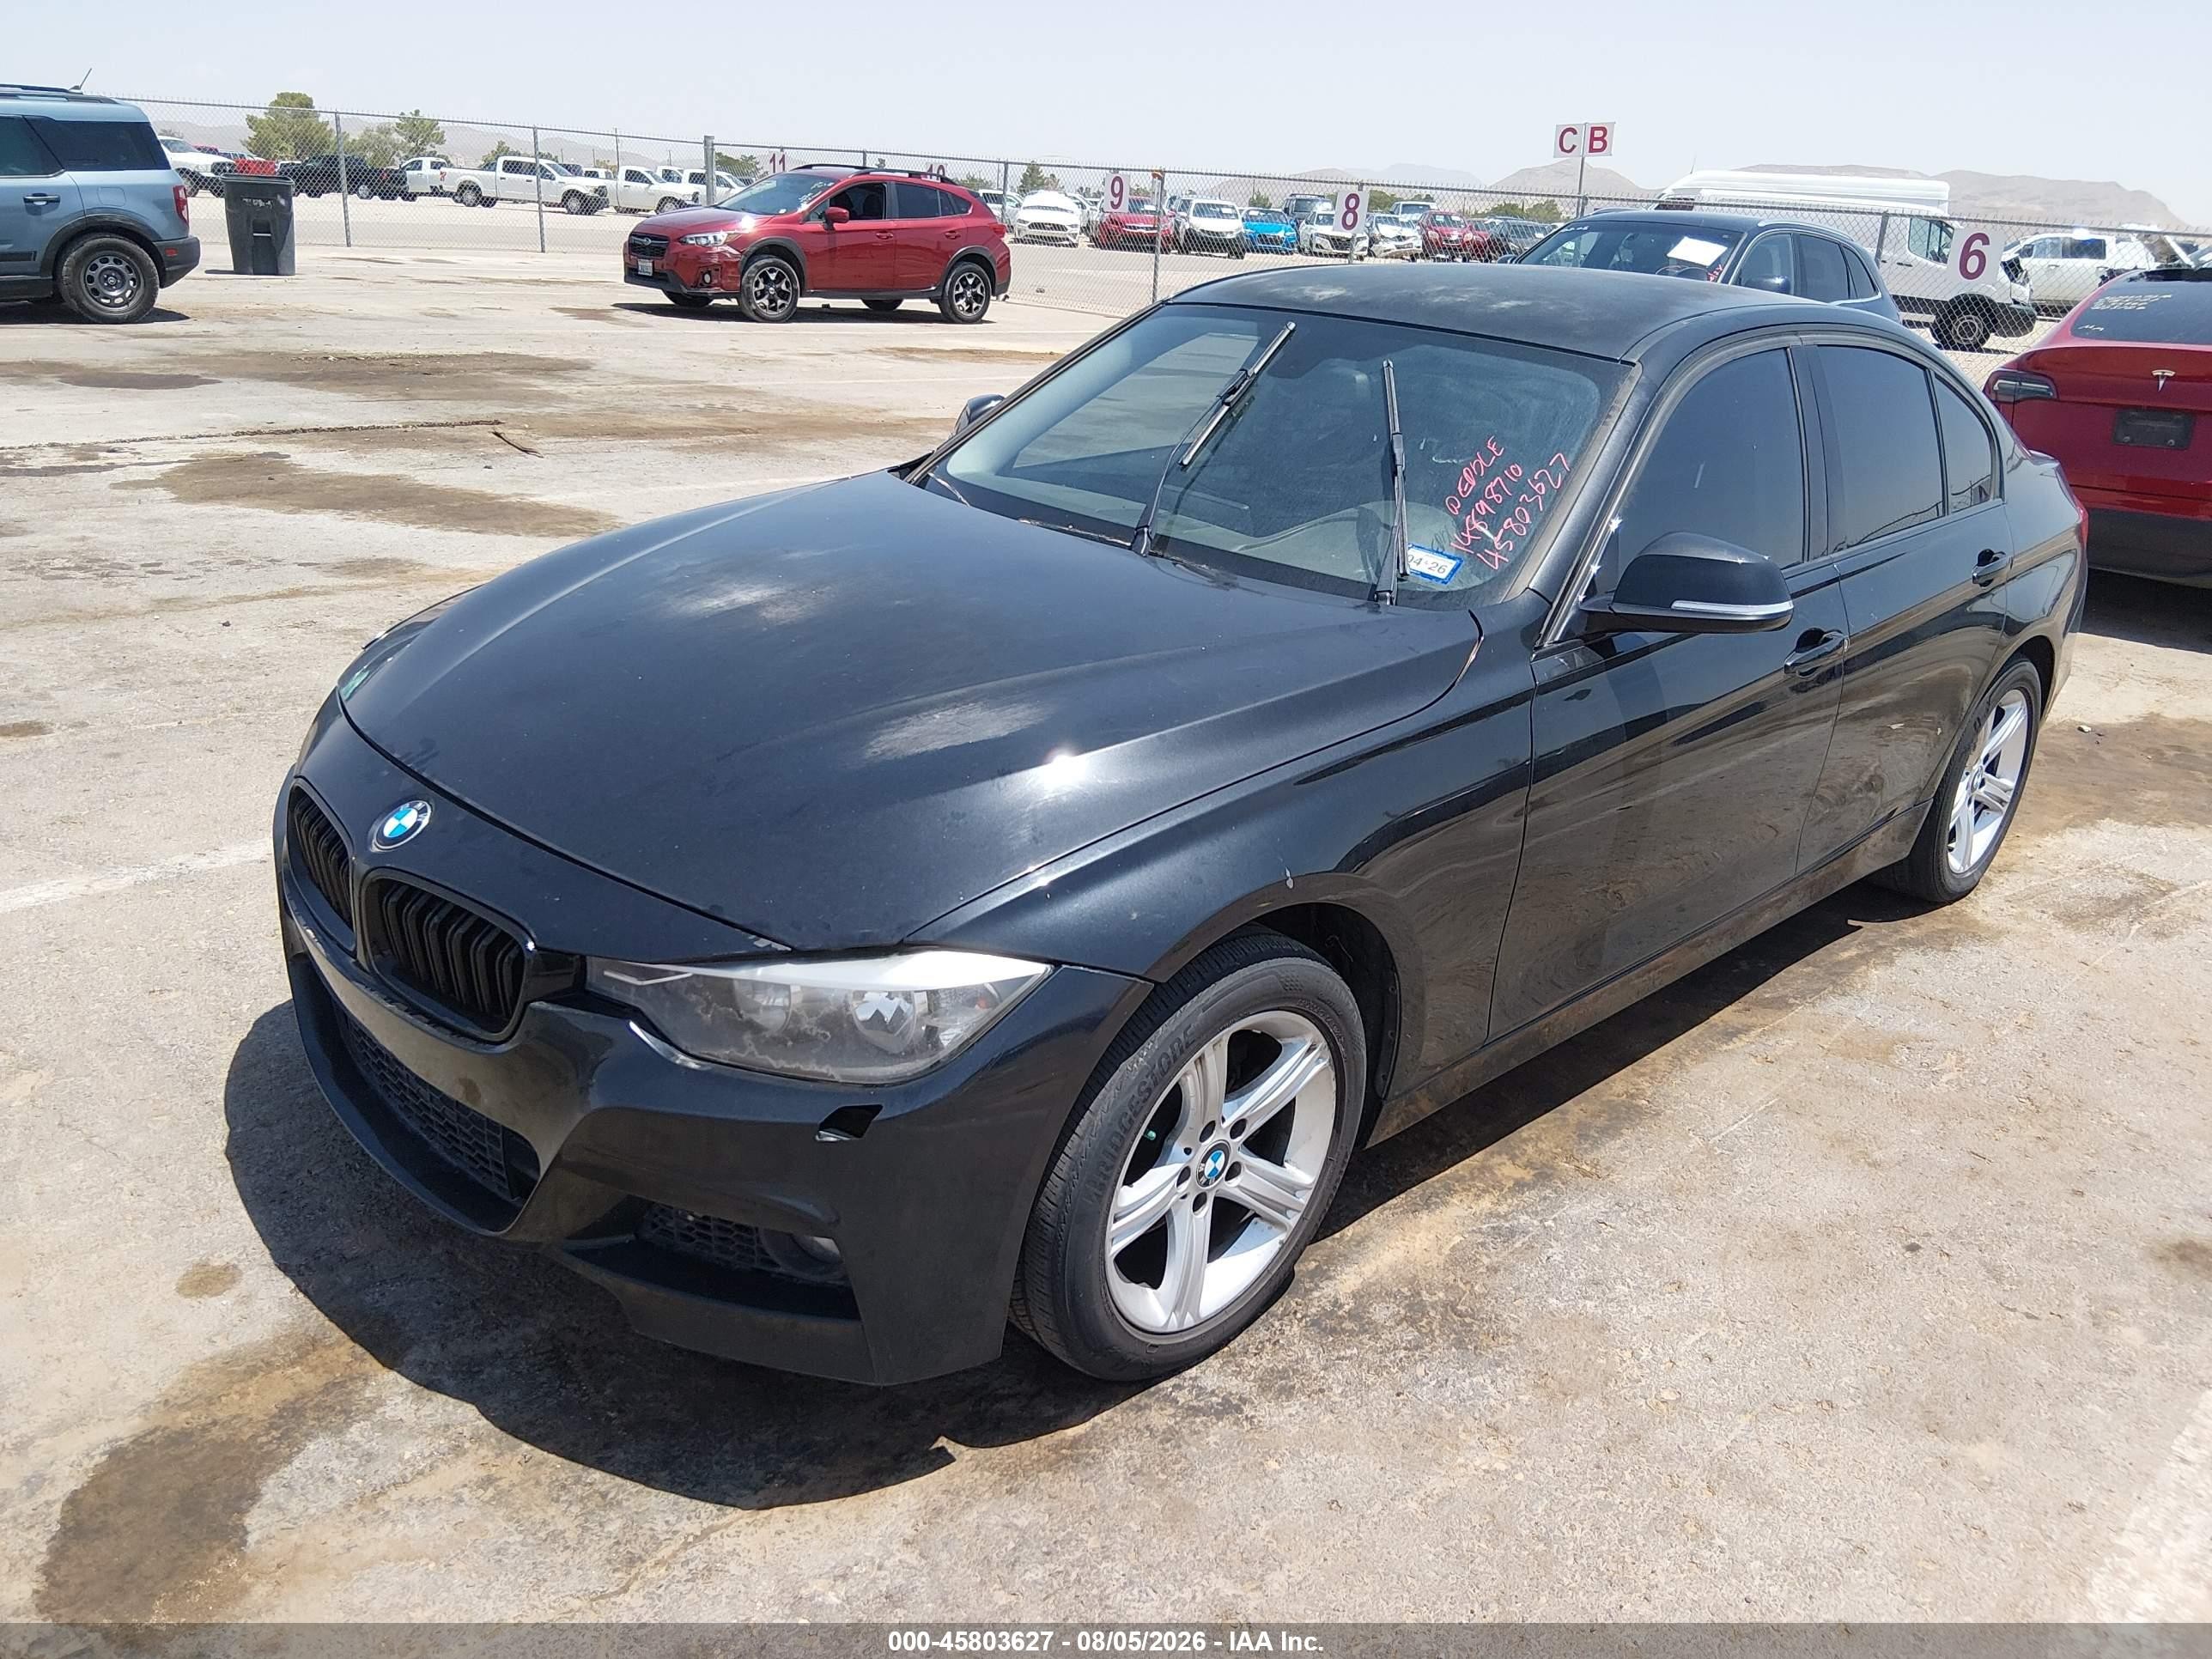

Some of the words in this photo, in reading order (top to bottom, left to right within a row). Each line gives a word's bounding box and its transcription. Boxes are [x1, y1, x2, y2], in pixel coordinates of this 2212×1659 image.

[1558, 126, 1577, 155] C
[1588, 125, 1609, 154] B
[769, 153, 787, 175] 11
[1109, 174, 1125, 210] 9
[1340, 192, 1361, 231] 8
[1959, 232, 1991, 281] 6
[1476, 452, 1571, 571] 45803627
